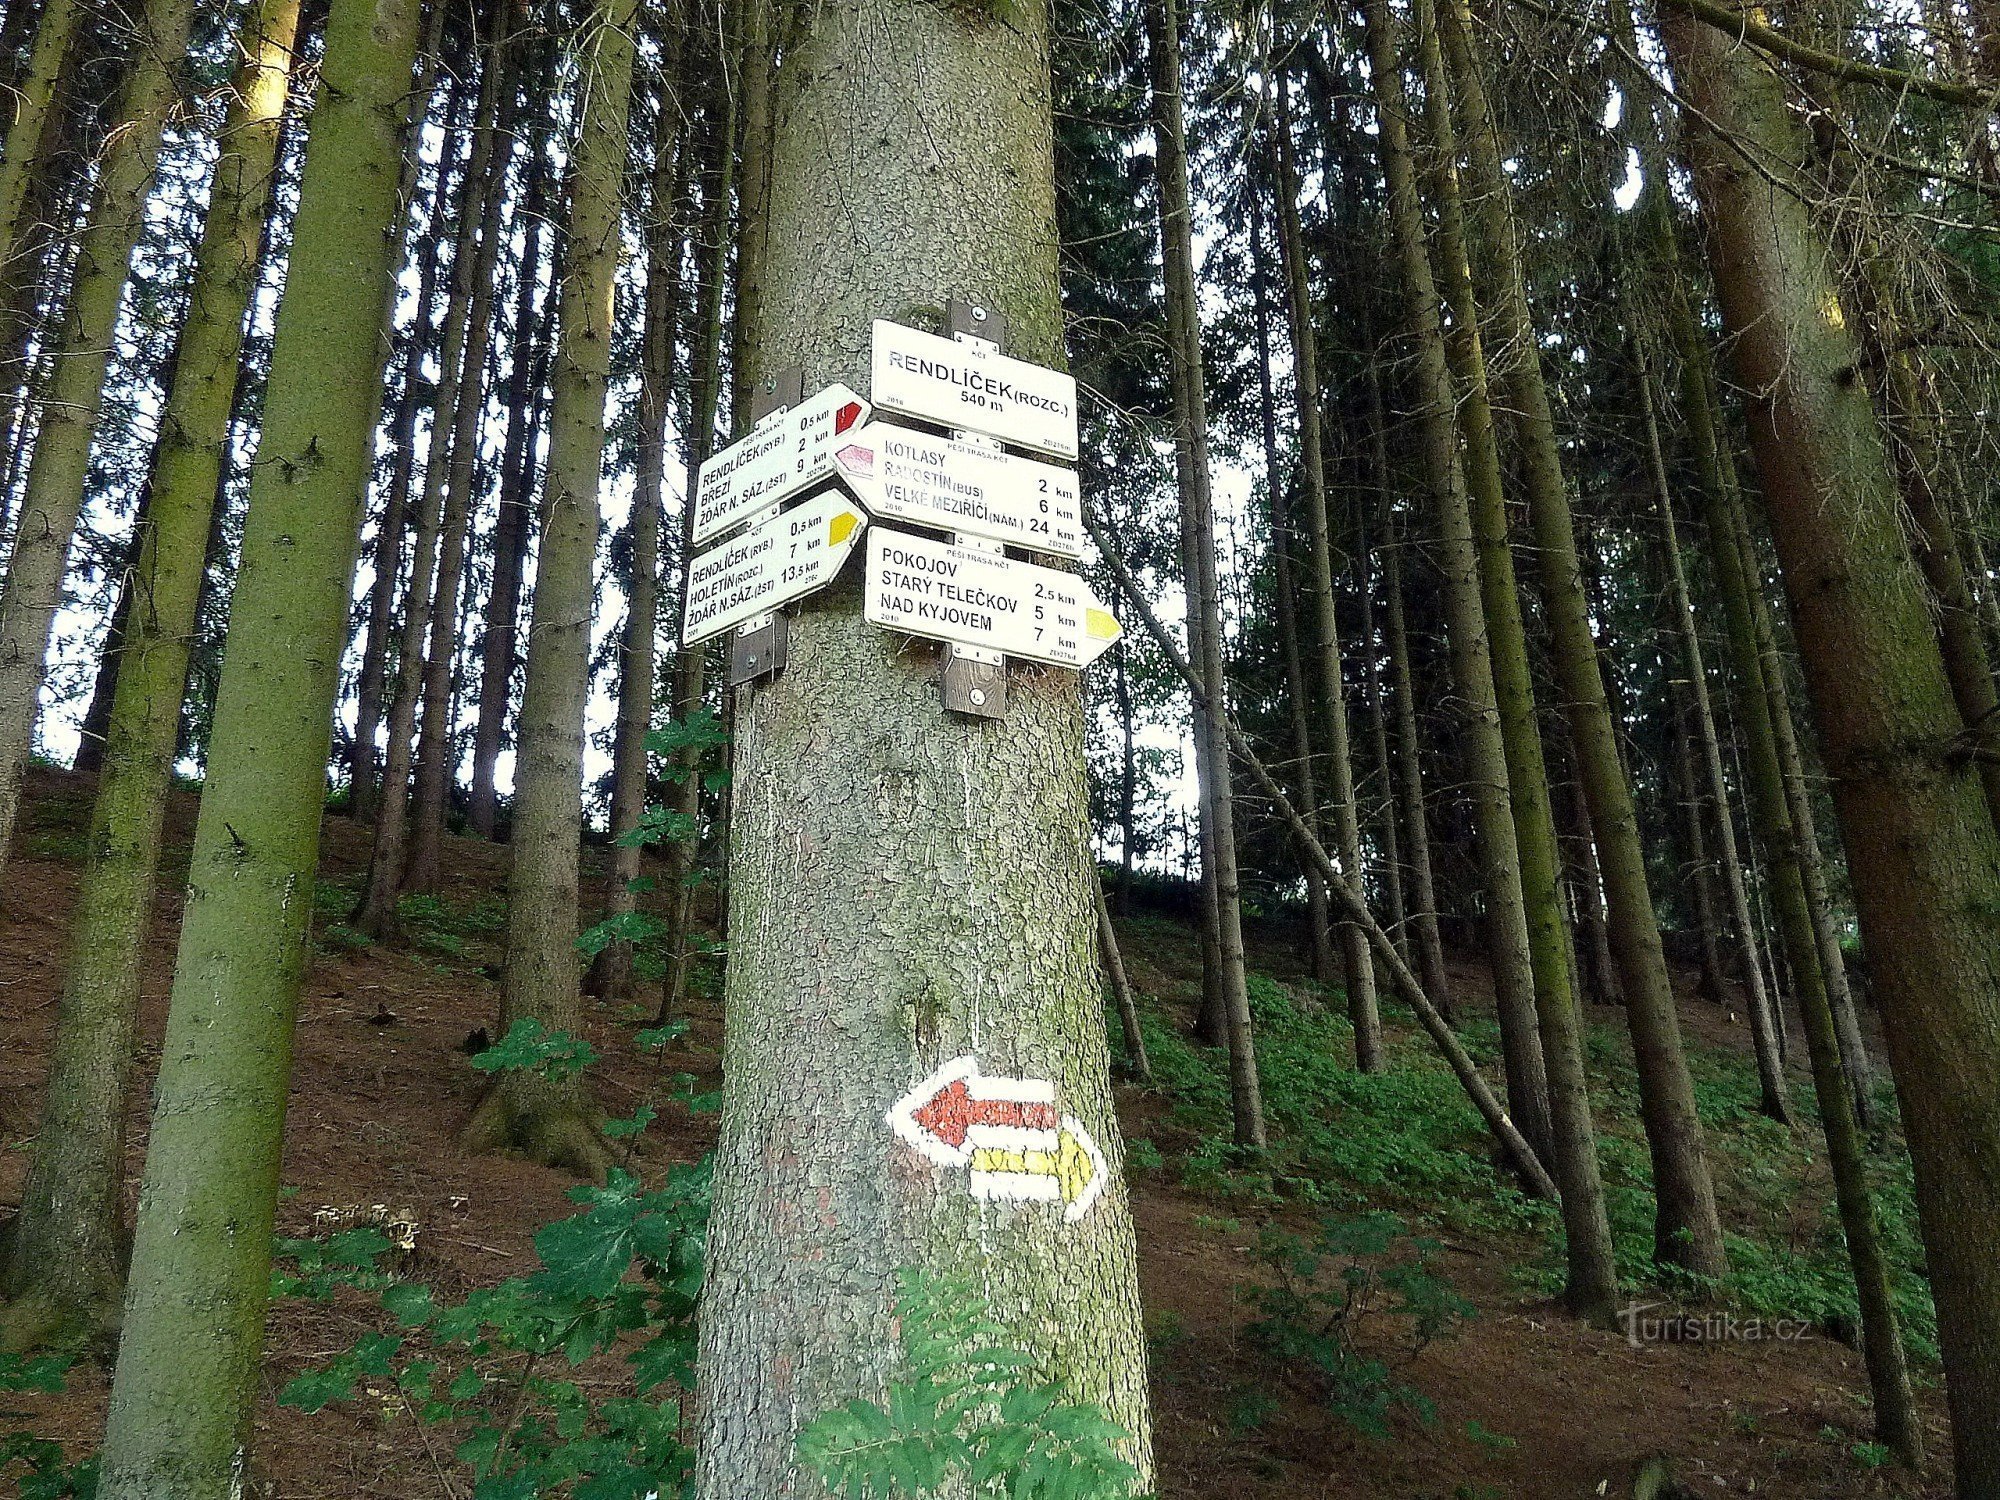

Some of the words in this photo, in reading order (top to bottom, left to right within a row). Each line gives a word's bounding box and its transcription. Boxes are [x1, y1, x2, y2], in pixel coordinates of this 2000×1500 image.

[960, 391, 985, 407] 540
[990, 401, 1004, 412] m
[816, 410, 829, 423] km
[701, 476, 731, 507] BŘEZÍ
[798, 438, 806, 453] 2
[815, 431, 828, 443] km
[797, 459, 804, 473] 9
[813, 452, 827, 465] km
[885, 440, 946, 467] KOTLASY
[1038, 479, 1047, 493] 2
[1056, 487, 1073, 499] km
[885, 483, 928, 506] VELKÉ
[1030, 518, 1049, 534] 24
[1057, 529, 1074, 541] km
[1039, 500, 1048, 513] 6
[1056, 507, 1073, 520] km
[808, 516, 822, 528] km
[790, 543, 798, 558] 7
[807, 538, 821, 551] km
[805, 560, 819, 574] km
[882, 547, 957, 577] POKOJOV
[1058, 592, 1075, 605] km
[882, 570, 932, 594] STARÝ
[937, 582, 1017, 613] TELEČKOV
[1034, 605, 1044, 620] 5
[1058, 614, 1076, 627] km
[880, 613, 899, 622] 2010
[881, 593, 914, 613] NAD
[918, 601, 992, 631] KYJOVEM
[1034, 627, 1044, 641] 7
[1058, 636, 1076, 649] km
